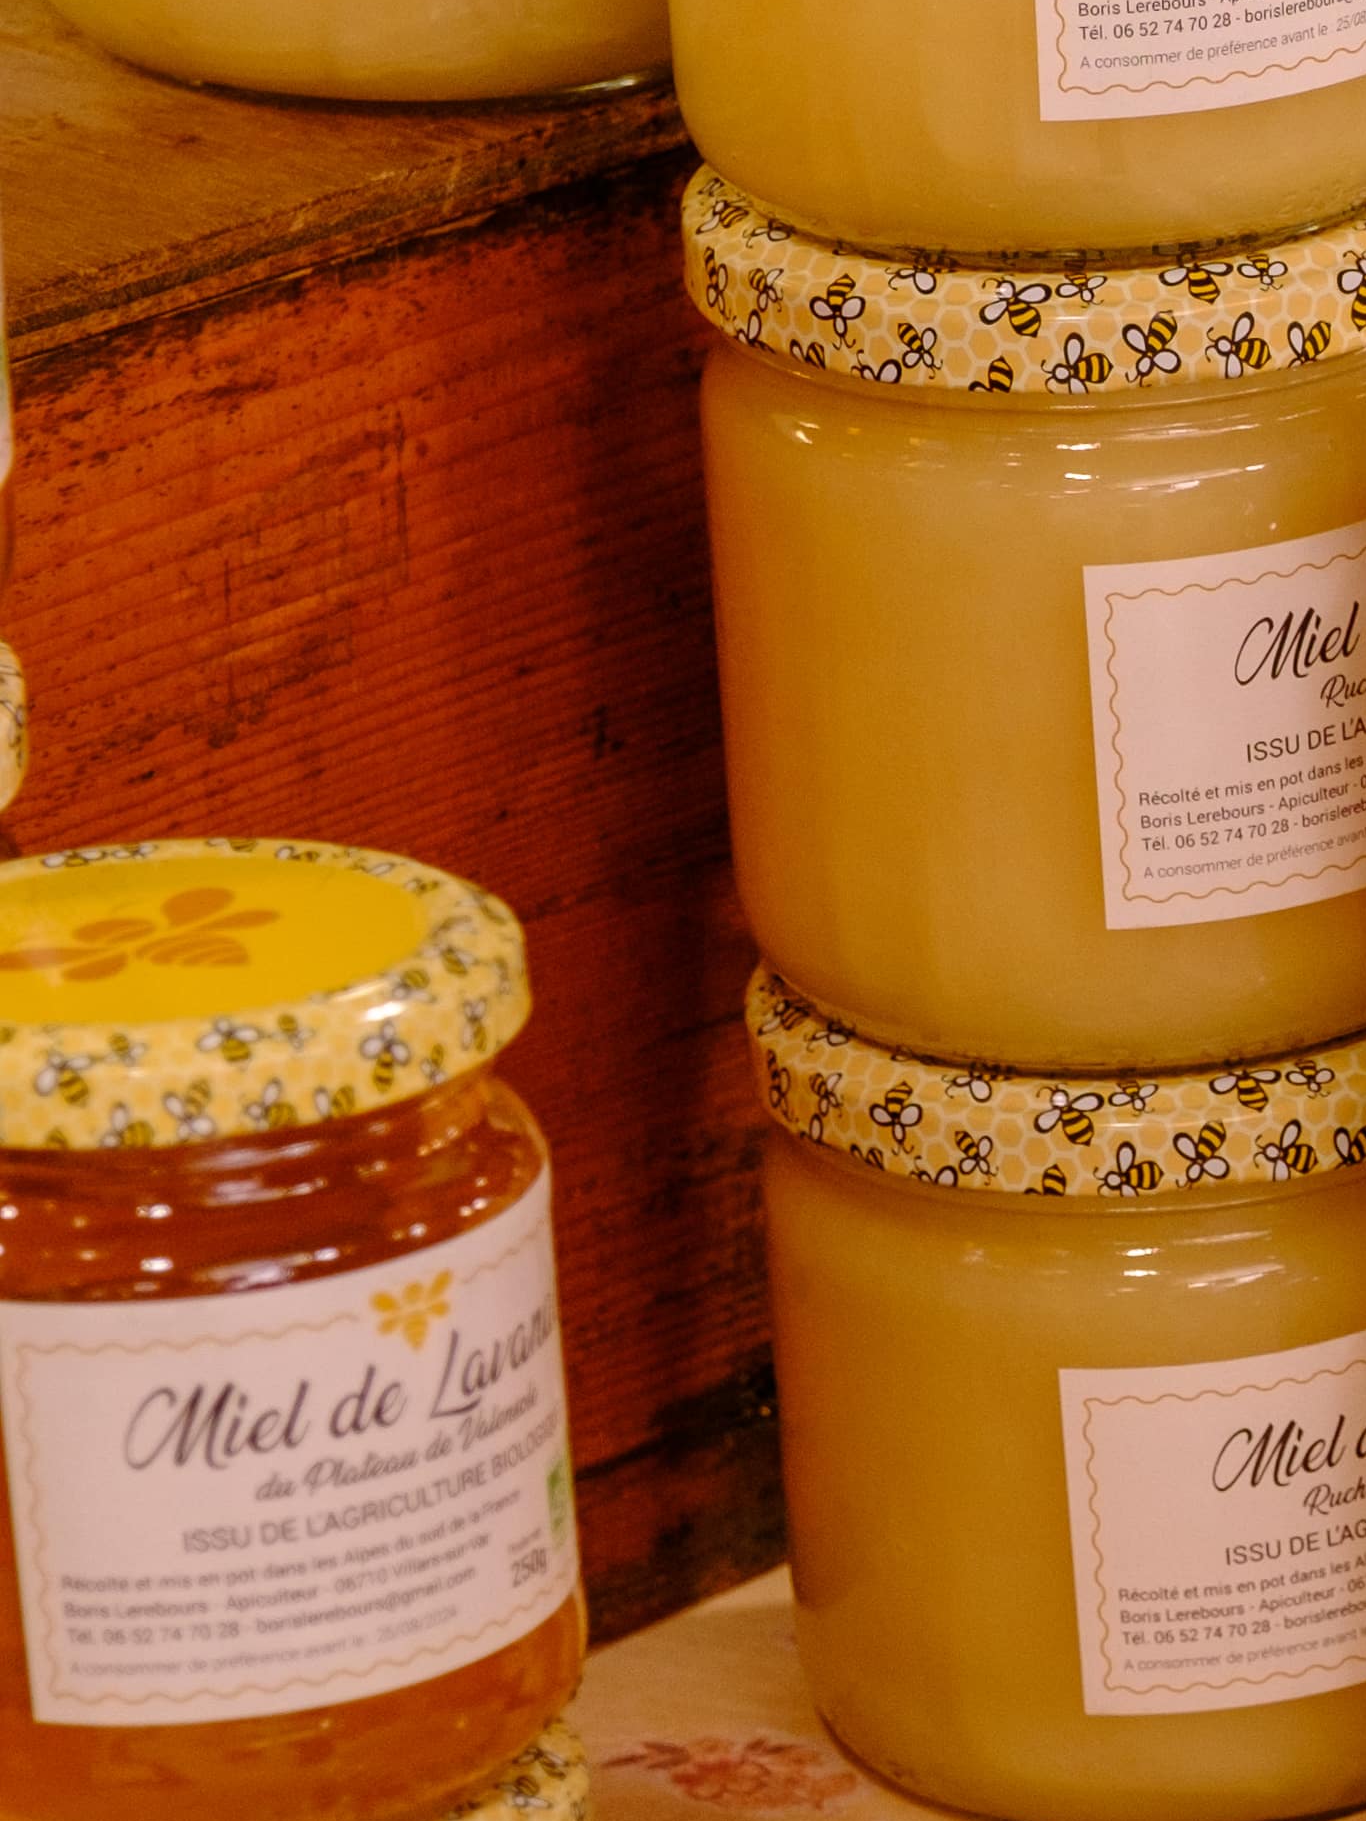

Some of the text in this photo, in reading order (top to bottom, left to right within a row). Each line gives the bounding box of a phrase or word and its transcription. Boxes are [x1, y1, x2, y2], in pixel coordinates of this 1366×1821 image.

[1234, 601, 1361, 690] Miel
[1246, 726, 1337, 764] ISSU DE
[127, 1379, 310, 1471] Miel
[328, 1364, 404, 1440] de
[422, 1433, 454, 1463] de
[1212, 1414, 1346, 1496] Miel
[181, 1452, 490, 1554] ISSU DE L'AGRICULTURE
[1225, 1539, 1282, 1566] ISSU
[1288, 1531, 1321, 1556] DE
